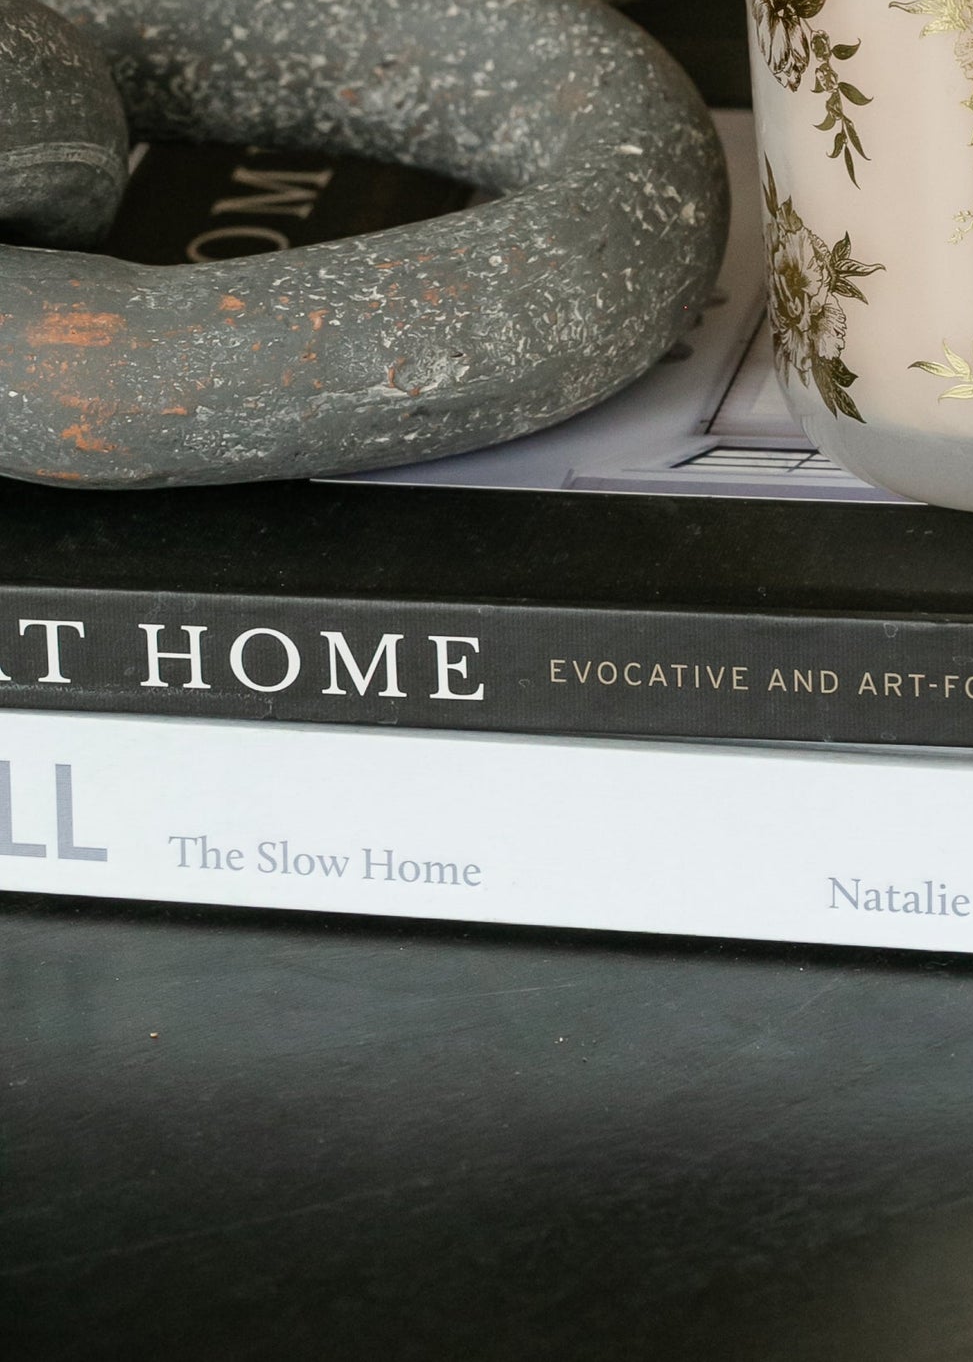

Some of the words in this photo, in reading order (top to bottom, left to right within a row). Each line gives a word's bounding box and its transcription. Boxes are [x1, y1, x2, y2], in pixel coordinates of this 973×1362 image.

[186, 145, 333, 262] OM
[0, 618, 85, 684] T
[137, 623, 485, 701] HOME
[550, 658, 749, 691] EVOCATIVE
[768, 668, 839, 694] AND
[168, 835, 245, 871] The
[257, 841, 350, 878] Slow
[362, 848, 482, 887] Home
[828, 876, 971, 918] Natalie
